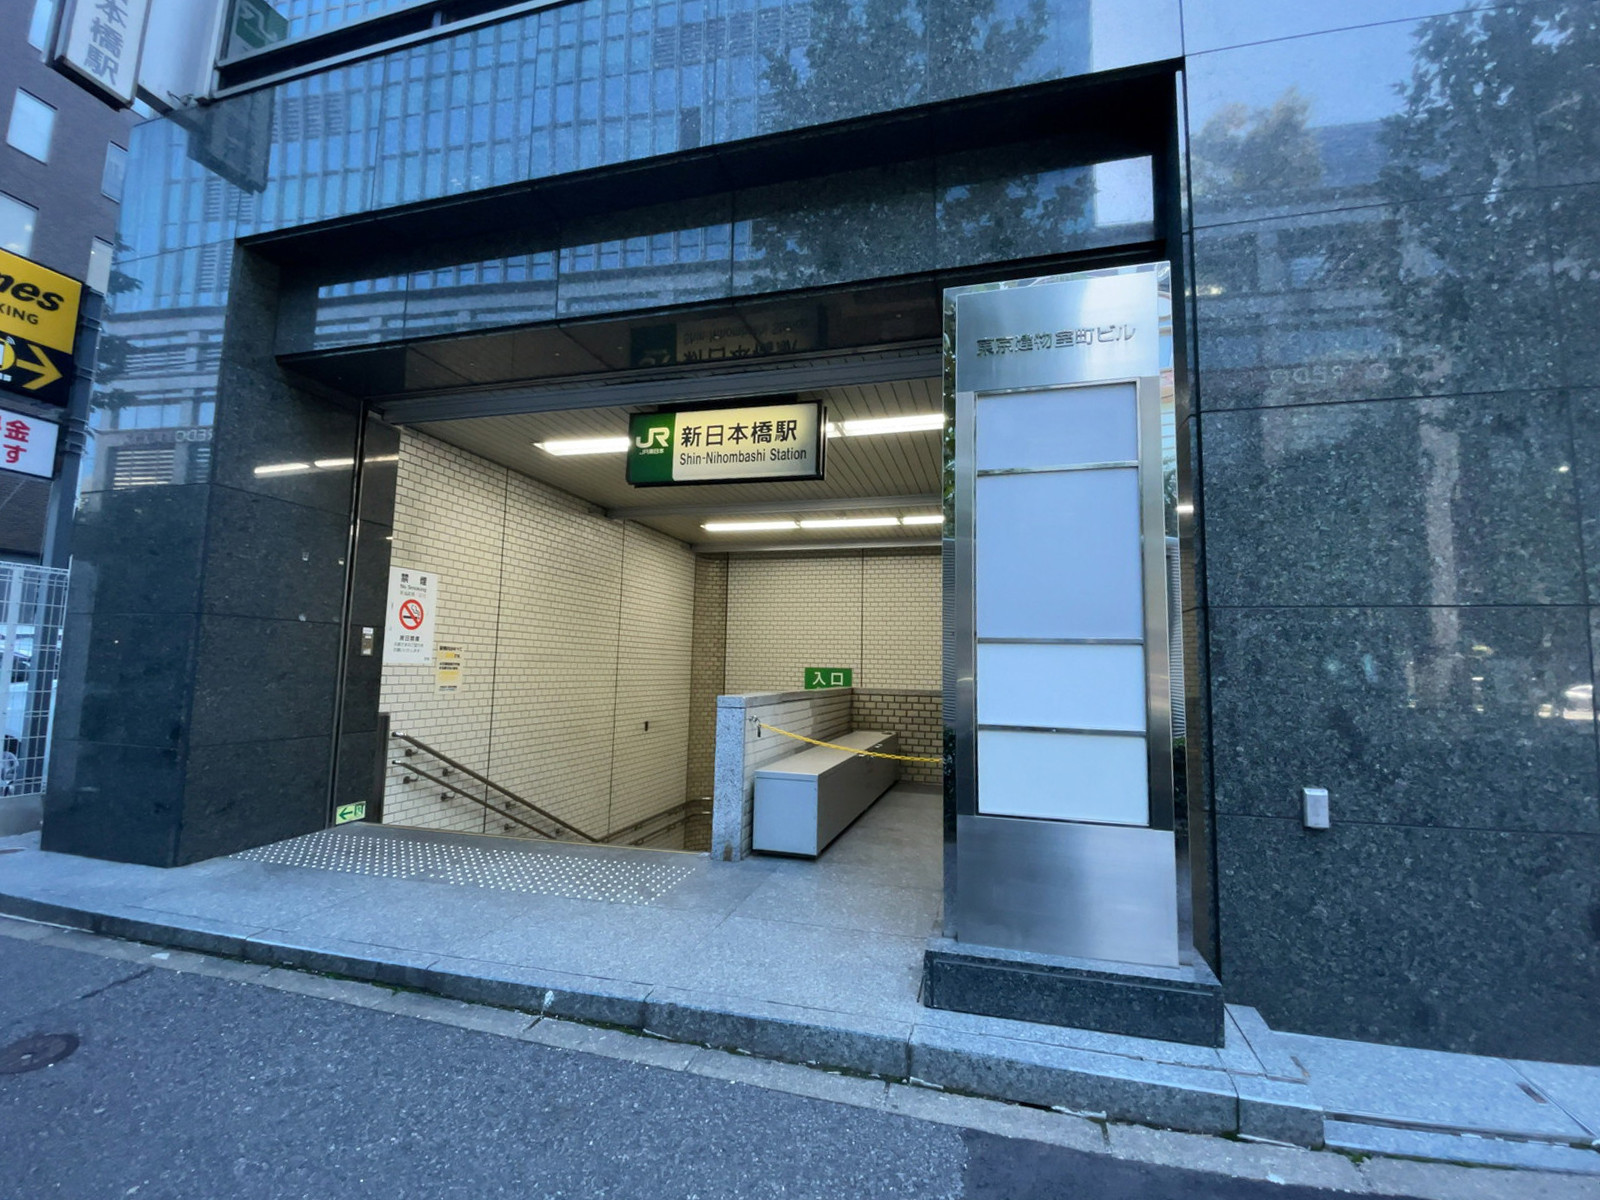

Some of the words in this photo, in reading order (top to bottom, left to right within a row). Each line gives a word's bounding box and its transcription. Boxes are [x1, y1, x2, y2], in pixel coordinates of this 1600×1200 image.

[83, 0, 129, 86] 本橋駅
[976, 324, 1137, 357] 東京建物室町ビル
[0, 415, 31, 443] 金
[635, 427, 670, 449] JR
[681, 420, 798, 448] 新日本橋駅
[679, 449, 766, 466] Shin-Nihombashi
[770, 447, 807, 461] Station
[812, 671, 844, 686] 入口
